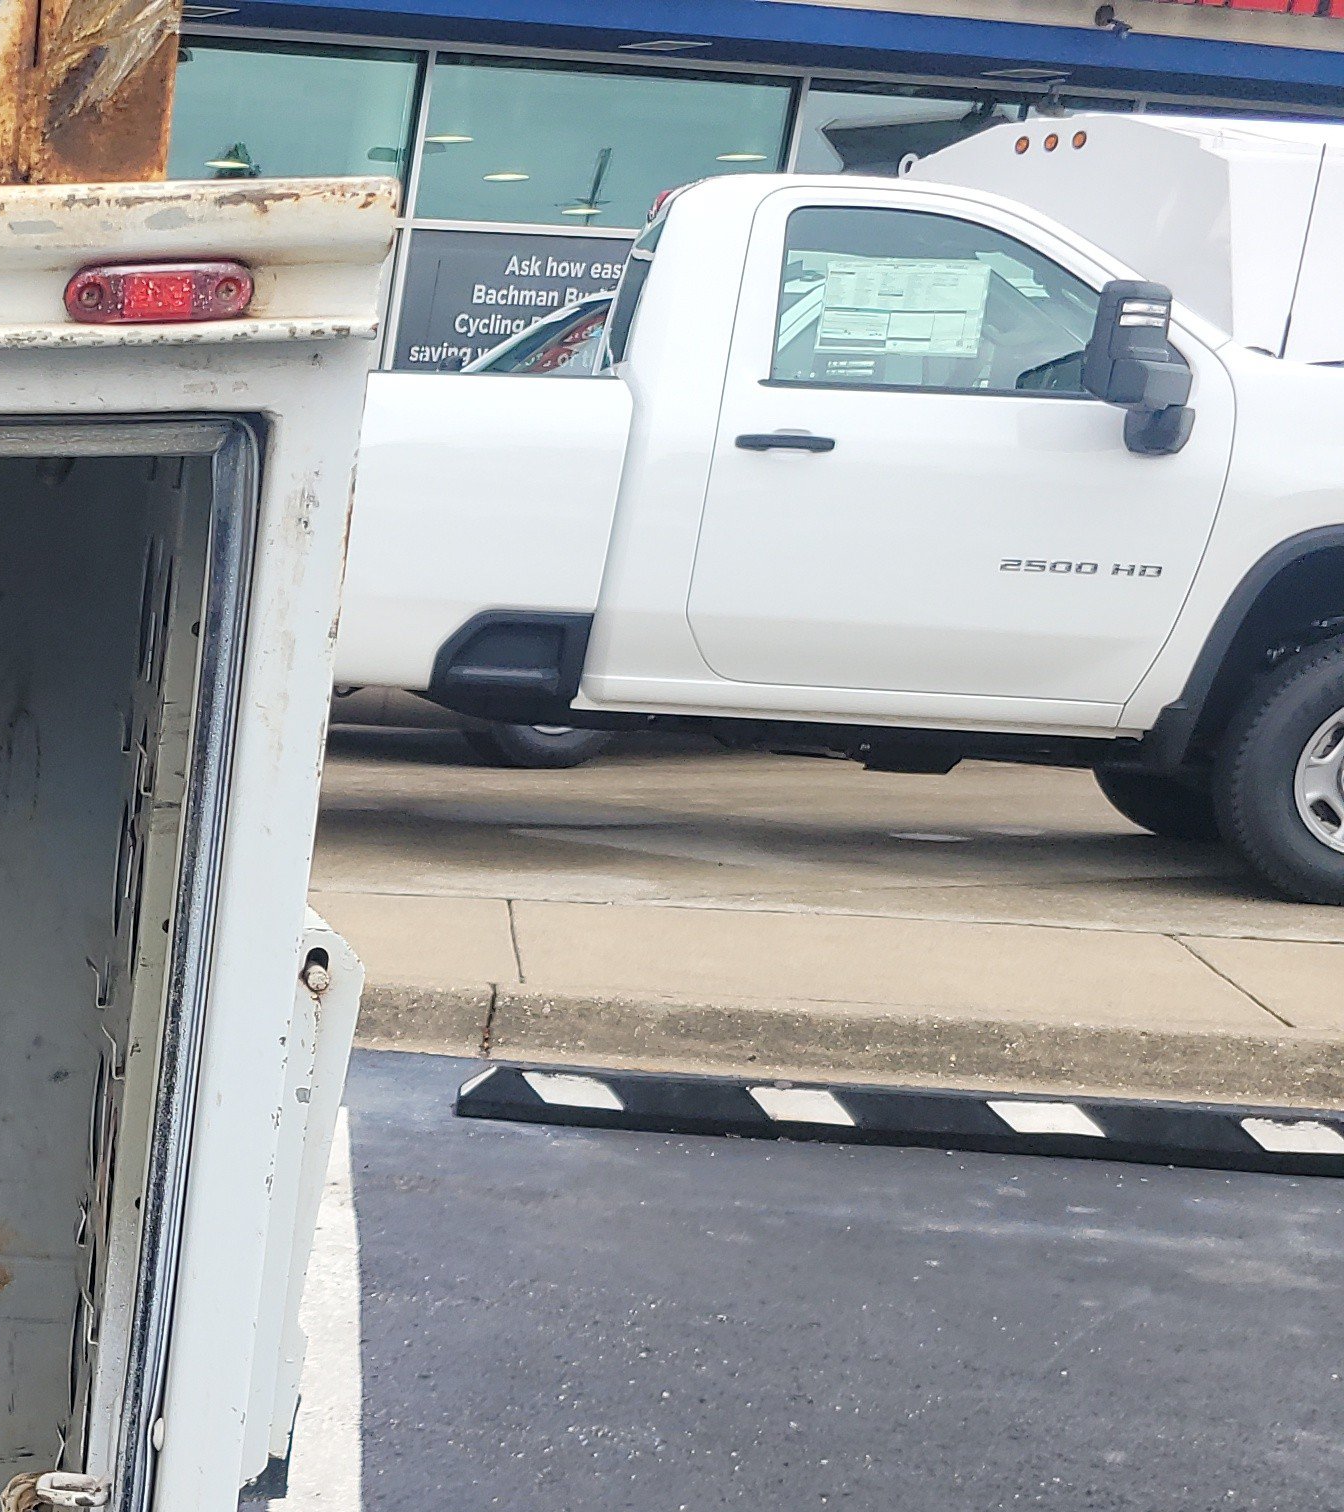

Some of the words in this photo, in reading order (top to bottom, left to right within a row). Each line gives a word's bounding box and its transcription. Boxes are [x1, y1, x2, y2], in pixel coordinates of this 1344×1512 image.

[504, 255, 541, 277] Ask
[545, 256, 587, 278] how
[590, 262, 625, 279] eas
[472, 285, 559, 307] Bachman
[454, 313, 526, 338] Cycling
[409, 342, 473, 366] saving
[999, 558, 1099, 575] 2500
[1111, 562, 1163, 578] HD
